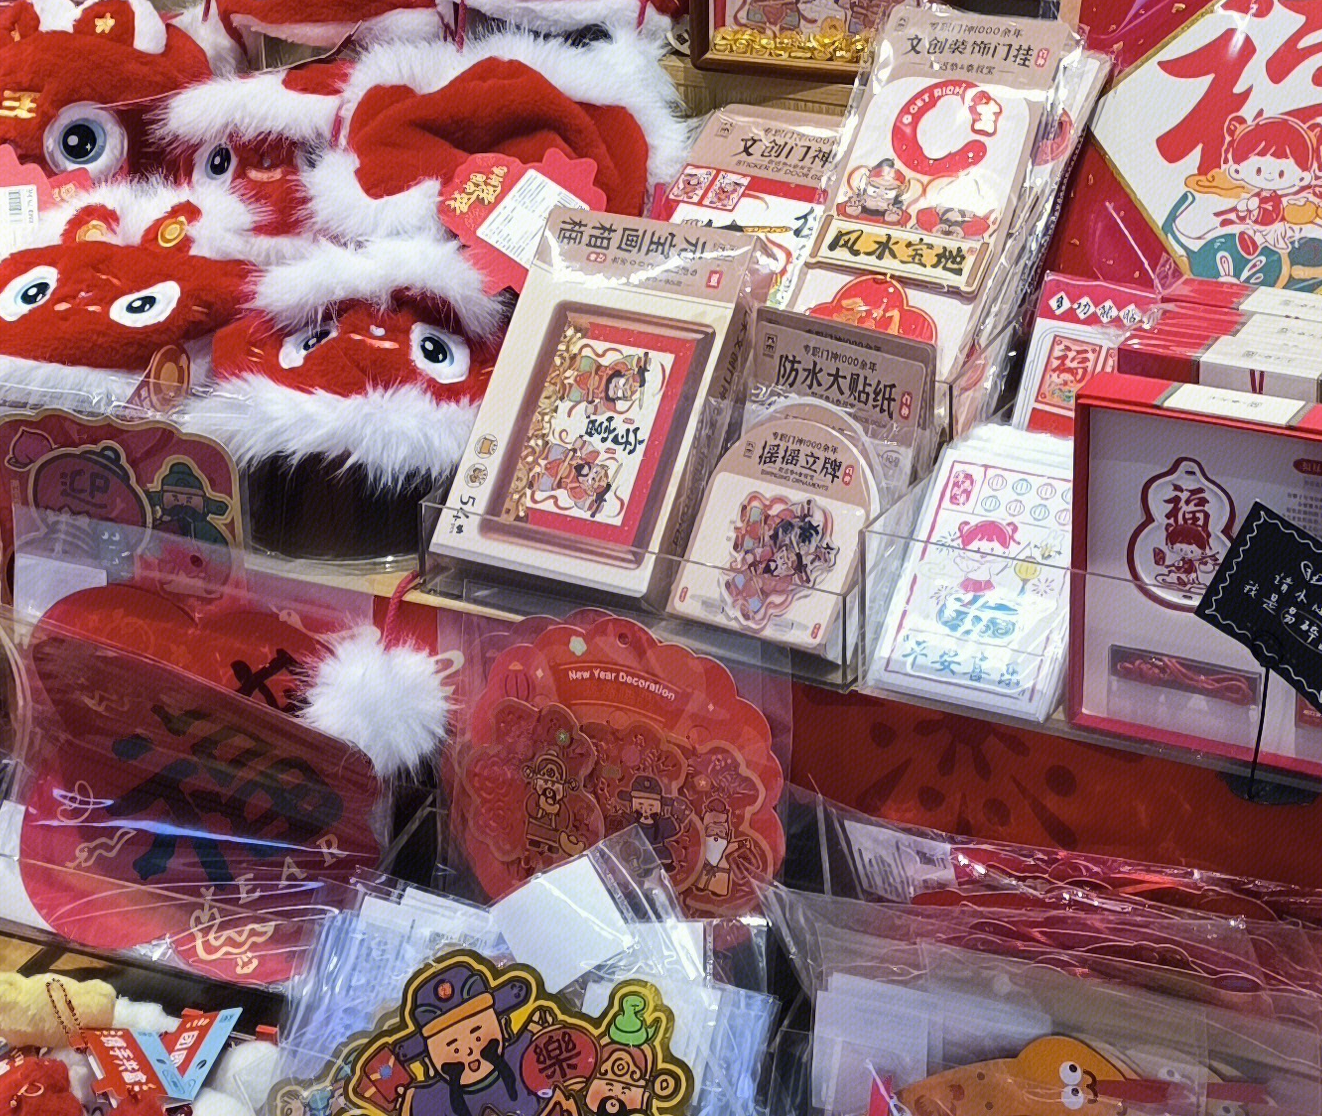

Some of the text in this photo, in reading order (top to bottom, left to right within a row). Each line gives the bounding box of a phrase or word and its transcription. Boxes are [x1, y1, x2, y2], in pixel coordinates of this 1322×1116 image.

[906, 35, 1034, 67] 文创装饰门挂
[731, 136, 831, 168] 文创门神
[828, 229, 965, 276] 风水宝地
[777, 354, 897, 420] 防水大贴纸
[758, 441, 843, 483] 摇摇立牌
[1162, 484, 1212, 529] 福
[568, 669, 677, 701] New Year Decoration
[534, 1031, 581, 1079] 樂
